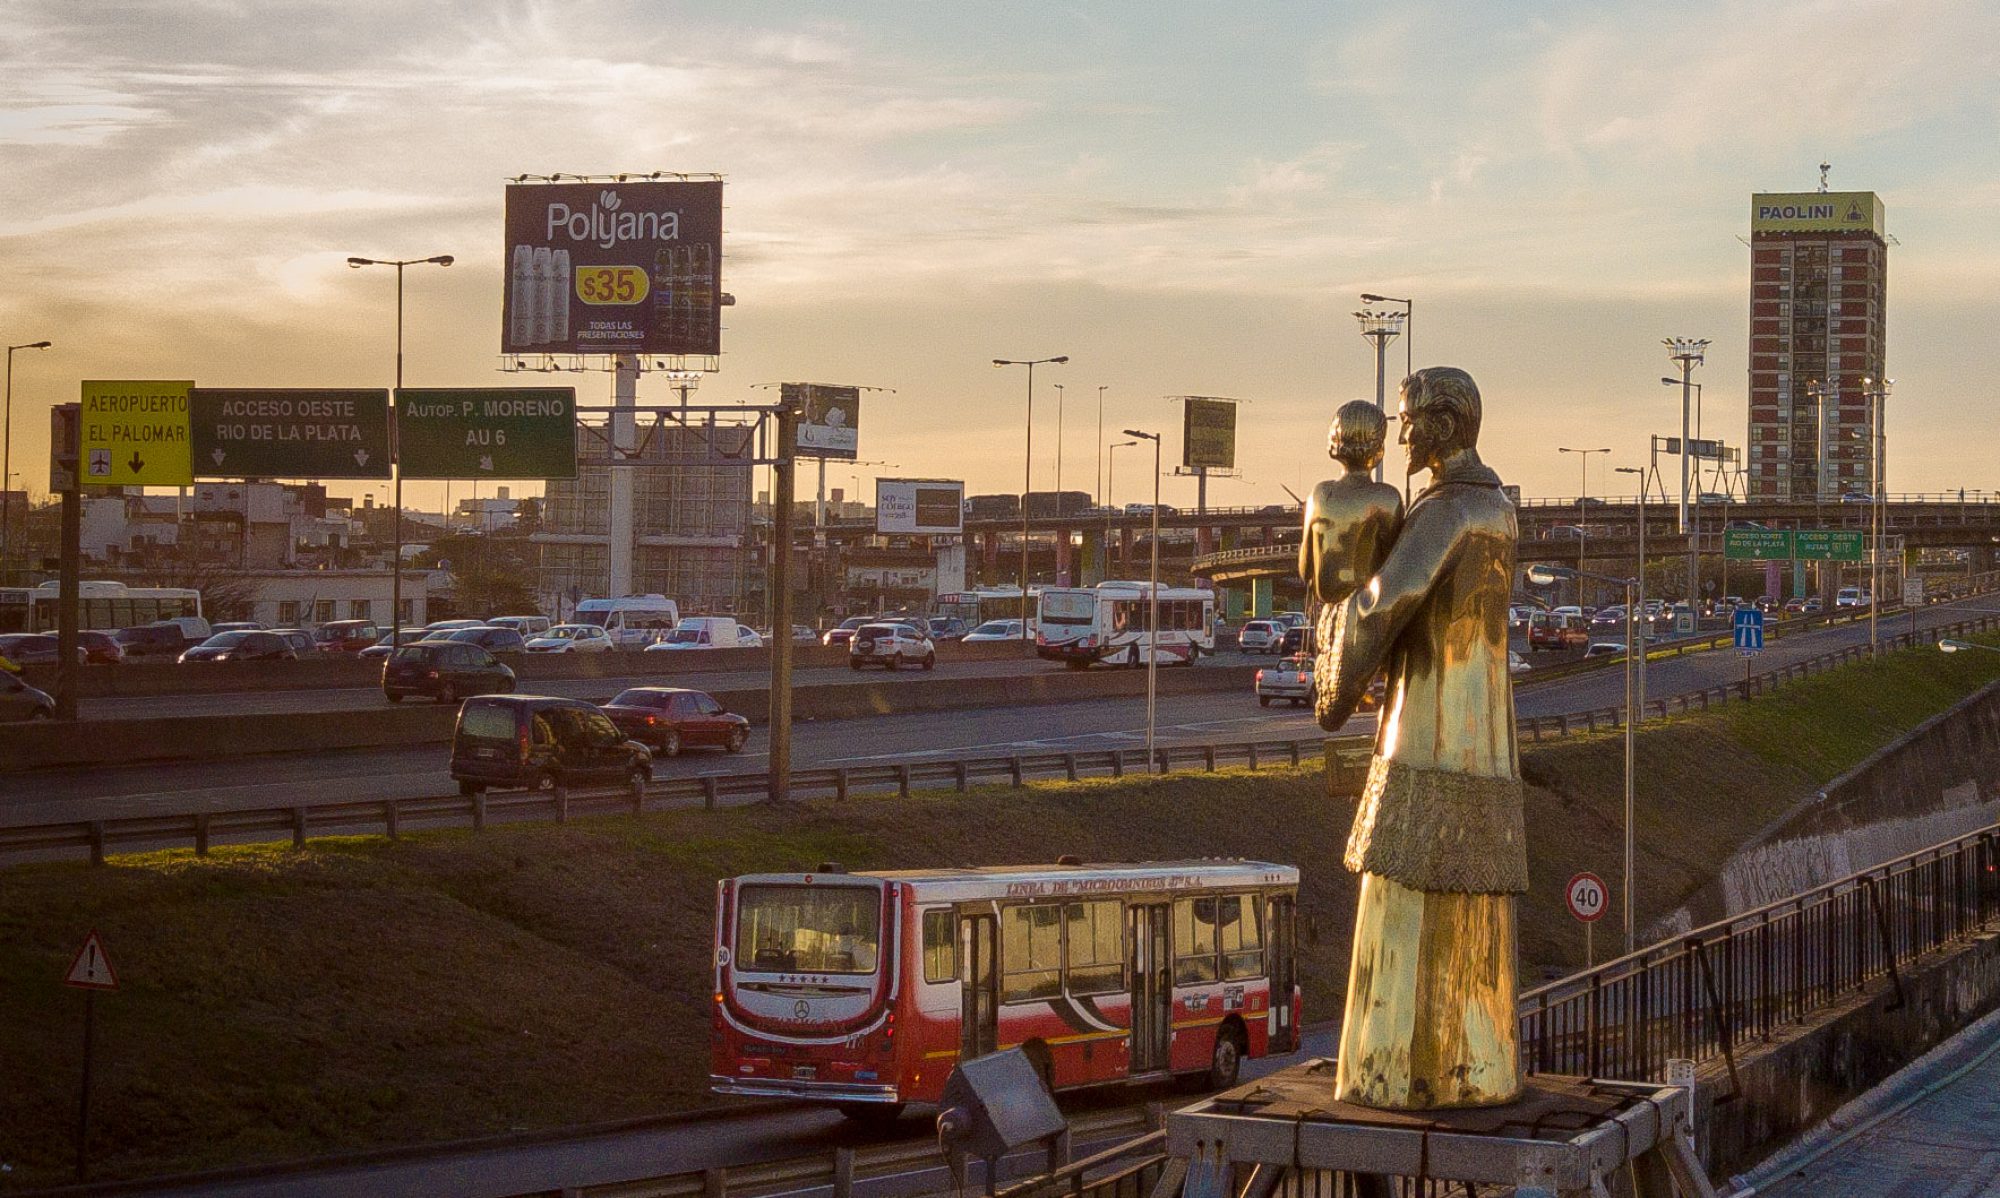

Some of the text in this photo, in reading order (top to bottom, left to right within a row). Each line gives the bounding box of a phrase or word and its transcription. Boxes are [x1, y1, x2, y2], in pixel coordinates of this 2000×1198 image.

[1759, 205, 1833, 219] PAOLINI
[547, 203, 679, 249] Polyana
[583, 269, 636, 302] $35
[589, 321, 633, 330] TODAS LAS
[577, 330, 645, 339] PRESENTACIONES
[88, 395, 188, 412] AEROPUERTO
[222, 400, 355, 417] ACCESO OESTE
[463, 401, 479, 417] P.
[484, 400, 565, 417] MORENO
[89, 425, 185, 442] EL PALOMAR
[216, 424, 362, 441] RIO DE LA PLATA
[465, 429, 506, 446] AU 6
[1763, 540, 1786, 548] PLATA
[1799, 533, 1829, 541] ACCESO
[1575, 887, 1599, 907] 40
[718, 949, 728, 963] 60
